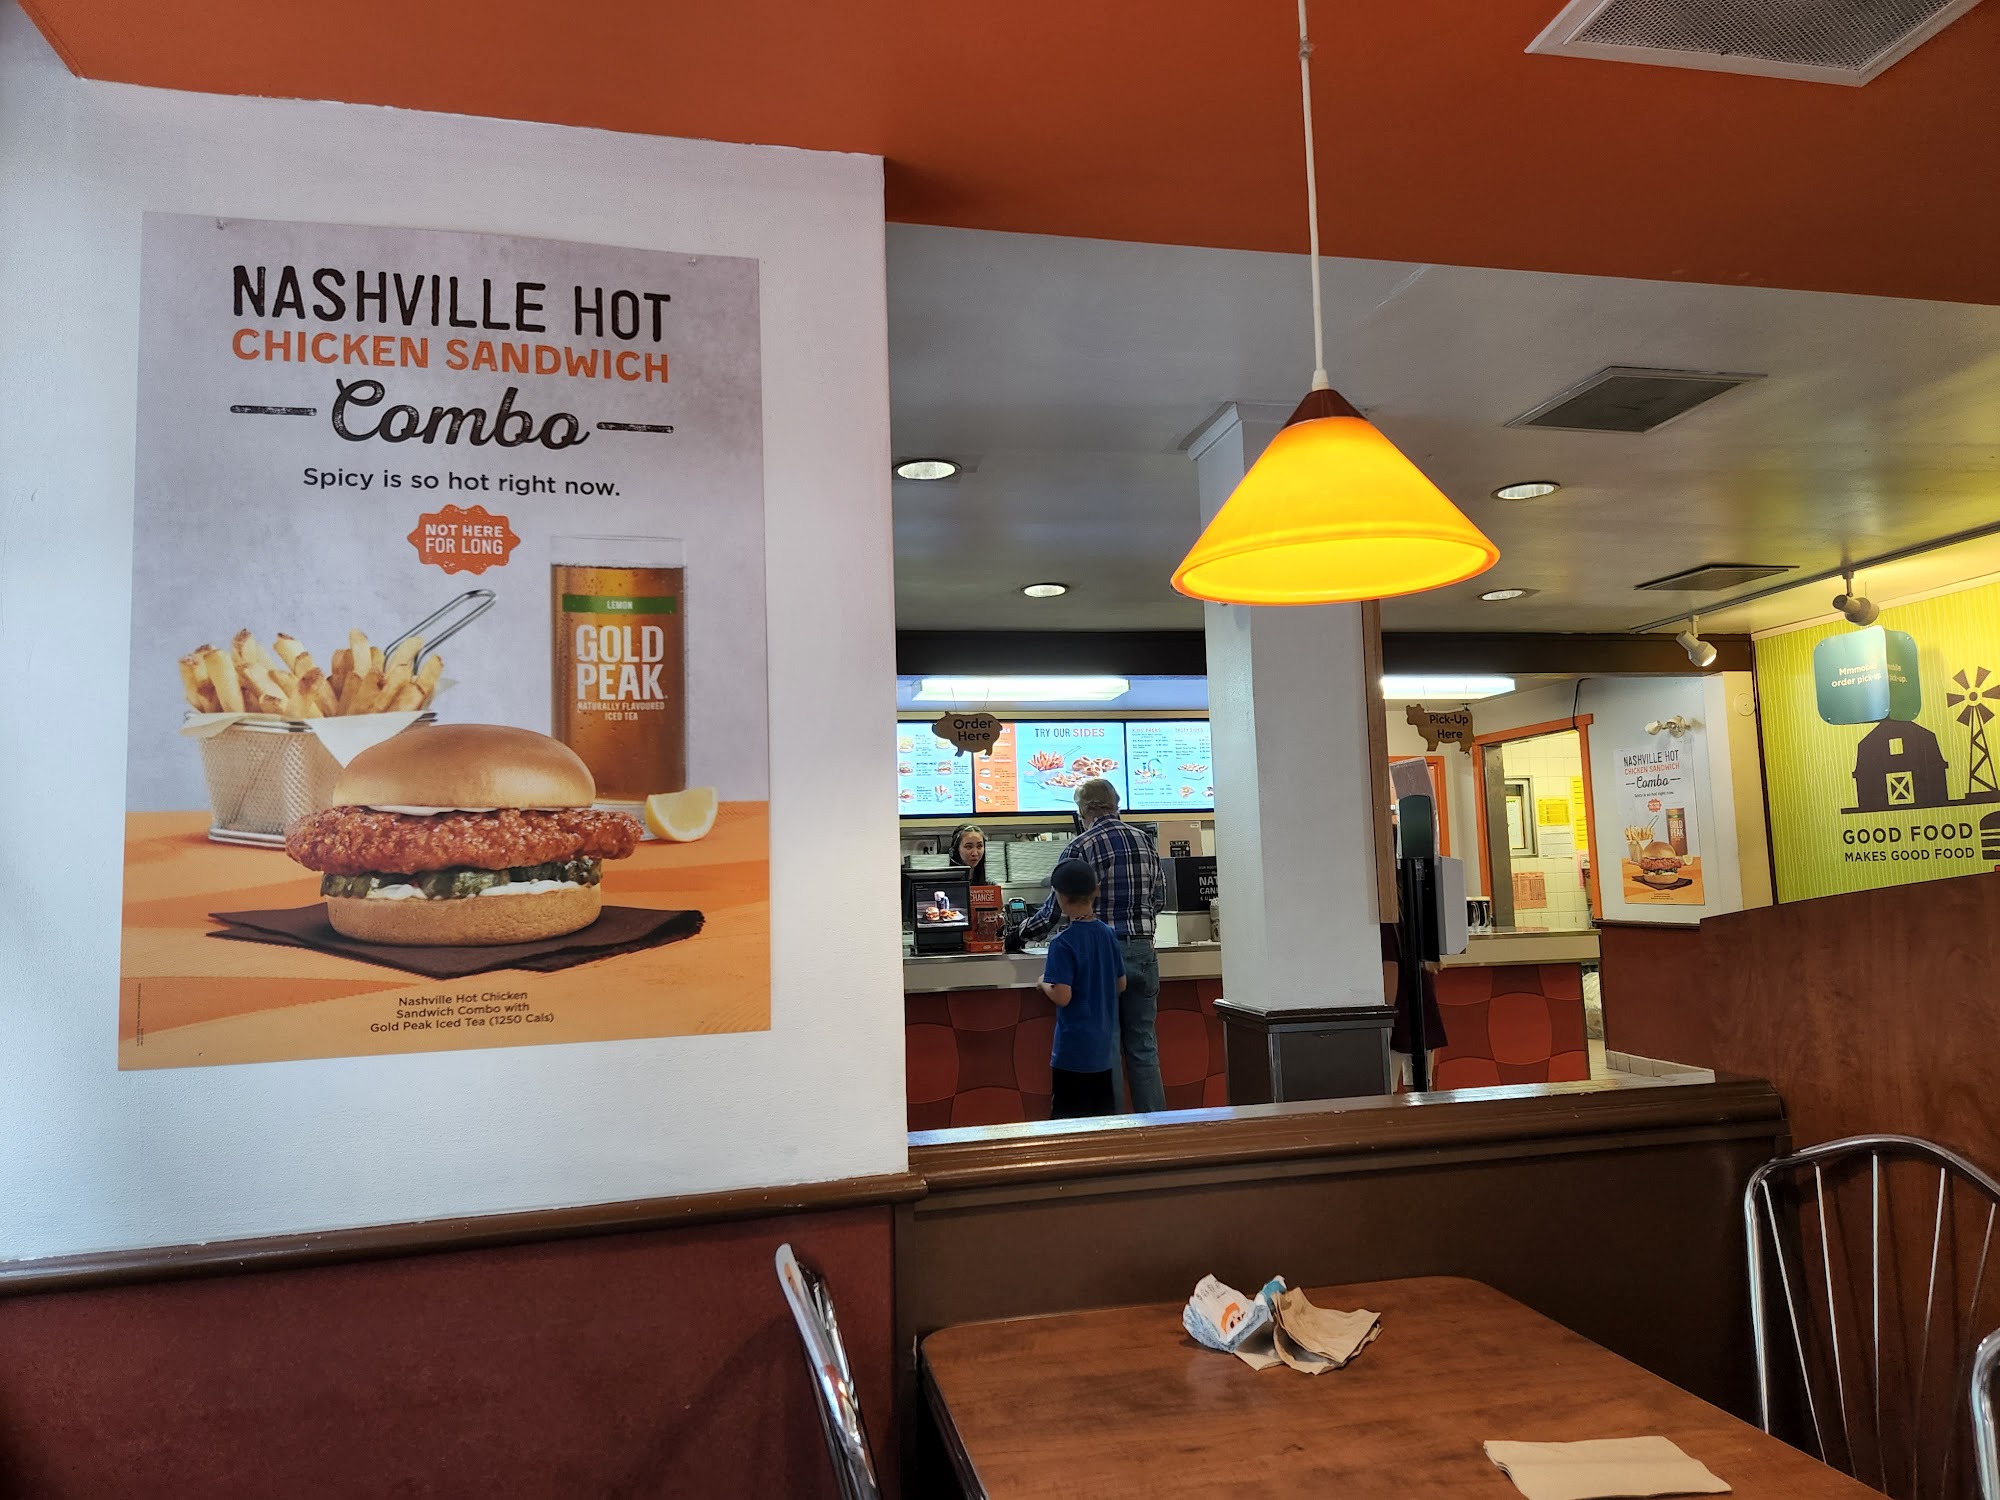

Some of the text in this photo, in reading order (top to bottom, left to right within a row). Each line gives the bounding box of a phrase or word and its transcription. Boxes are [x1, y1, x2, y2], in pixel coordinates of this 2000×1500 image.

[233, 265, 671, 342] NASHVILLE HOT
[232, 328, 668, 383] CHICKEN SANDWICH
[332, 378, 590, 450] Combo
[303, 467, 621, 497] Spicy is so hot right now.
[425, 524, 504, 538] NOT HERE
[425, 538, 503, 555] FOR LONG
[606, 600, 633, 610] LEMON
[575, 624, 664, 663] GOLD
[1839, 663, 1878, 676] Mmmobile
[576, 663, 665, 701] PEAK
[1831, 677, 1856, 687] order
[577, 701, 665, 711] NATURALLY FLAVOURED
[605, 712, 639, 720] ICED TEA
[953, 718, 993, 729] Order
[1429, 714, 1469, 726] Pick-Up
[958, 731, 991, 741] Here
[1034, 728, 1105, 738] TRY OUR SIDES
[1437, 729, 1463, 739] Here
[1623, 749, 1679, 767] NASHVILLE HOT
[1624, 762, 1680, 775] CHICKEN SANDWICH
[1636, 774, 1670, 789] Combo
[1671, 828, 1684, 837] PEAK
[1842, 823, 1973, 844] GOOD FOOD
[1845, 847, 1975, 862] MAKES GOOD FOOD
[398, 991, 528, 1006] Nashville Hot Chicken
[396, 1002, 529, 1019] Sandwich Combo with
[370, 1012, 555, 1033] Gold Peak Iced Tea (1250 Cals)
